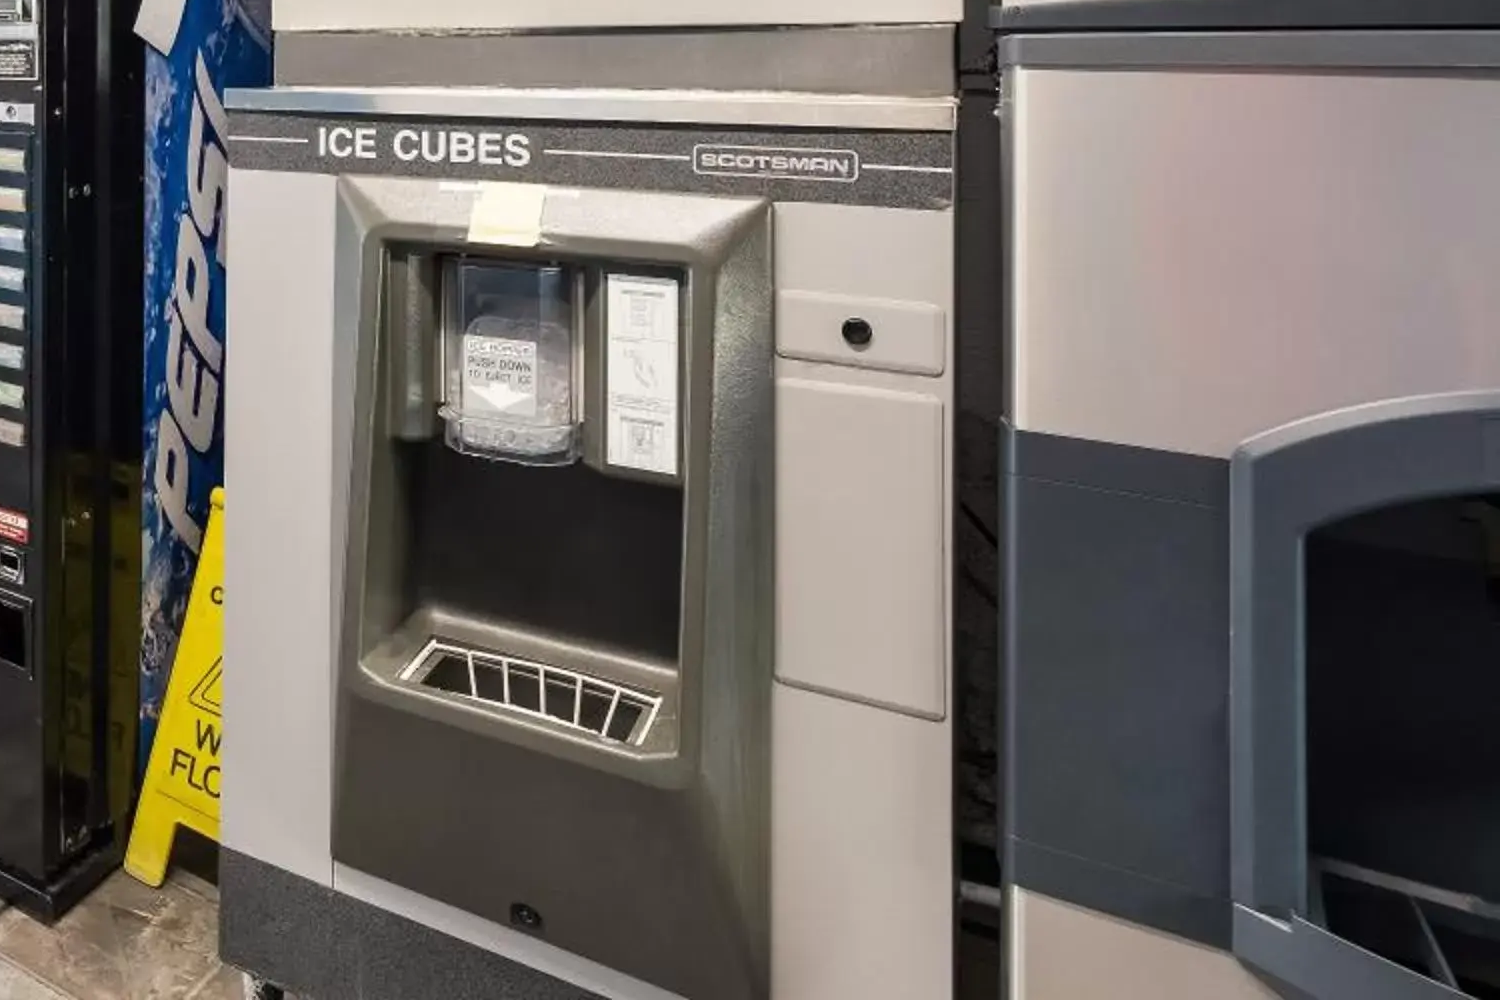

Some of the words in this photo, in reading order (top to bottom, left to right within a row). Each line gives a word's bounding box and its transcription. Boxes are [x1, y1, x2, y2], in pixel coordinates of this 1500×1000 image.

[318, 127, 377, 159] ICE
[393, 129, 531, 168] CUBES
[700, 153, 850, 174] SCOTSMAN
[155, 48, 228, 556] PEPSI
[468, 355, 496, 369] PUSH
[500, 359, 532, 373] DOWN
